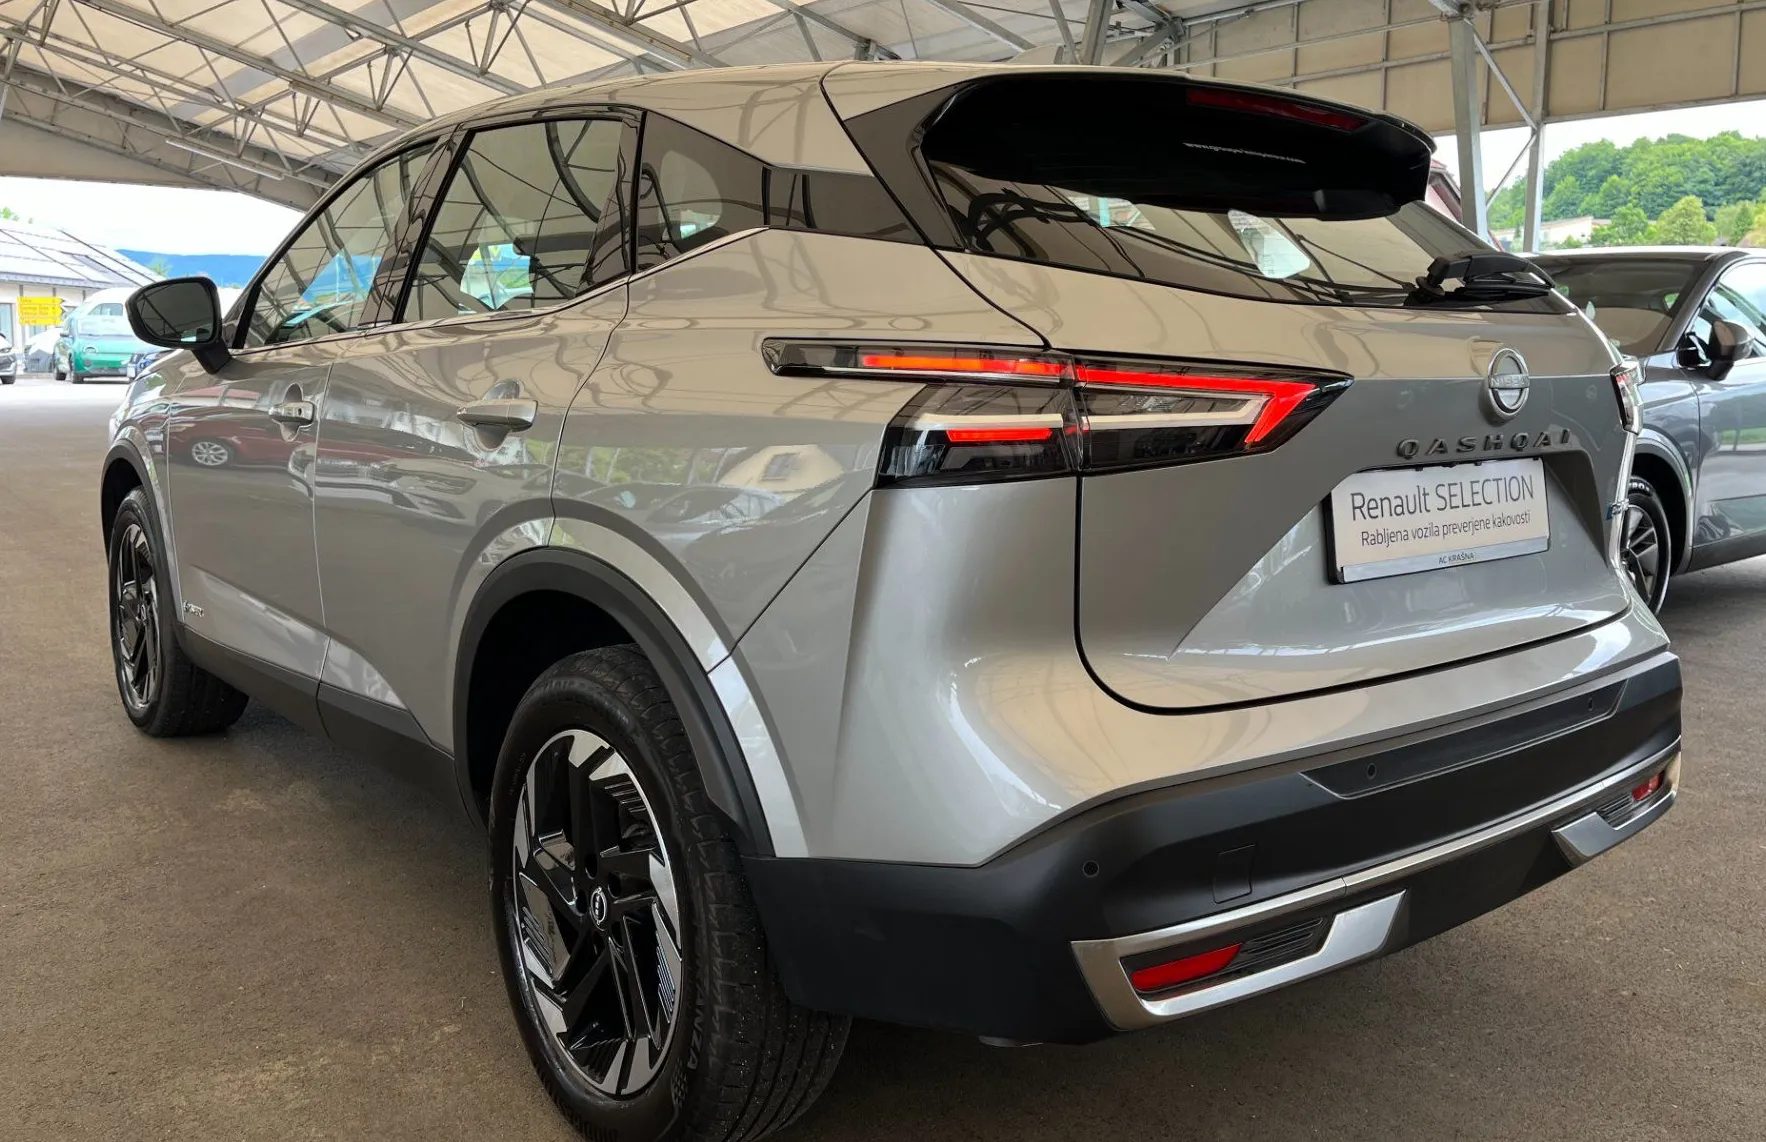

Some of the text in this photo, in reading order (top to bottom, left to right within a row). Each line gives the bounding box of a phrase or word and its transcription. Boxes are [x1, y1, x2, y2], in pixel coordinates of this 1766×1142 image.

[1396, 428, 1571, 459] QASHQAI
[1350, 475, 1534, 521] Renault SELECTION
[1361, 510, 1531, 548] Rabljena vozila preverjene kakovosti
[1438, 552, 1475, 565] AC KRAŠNA
